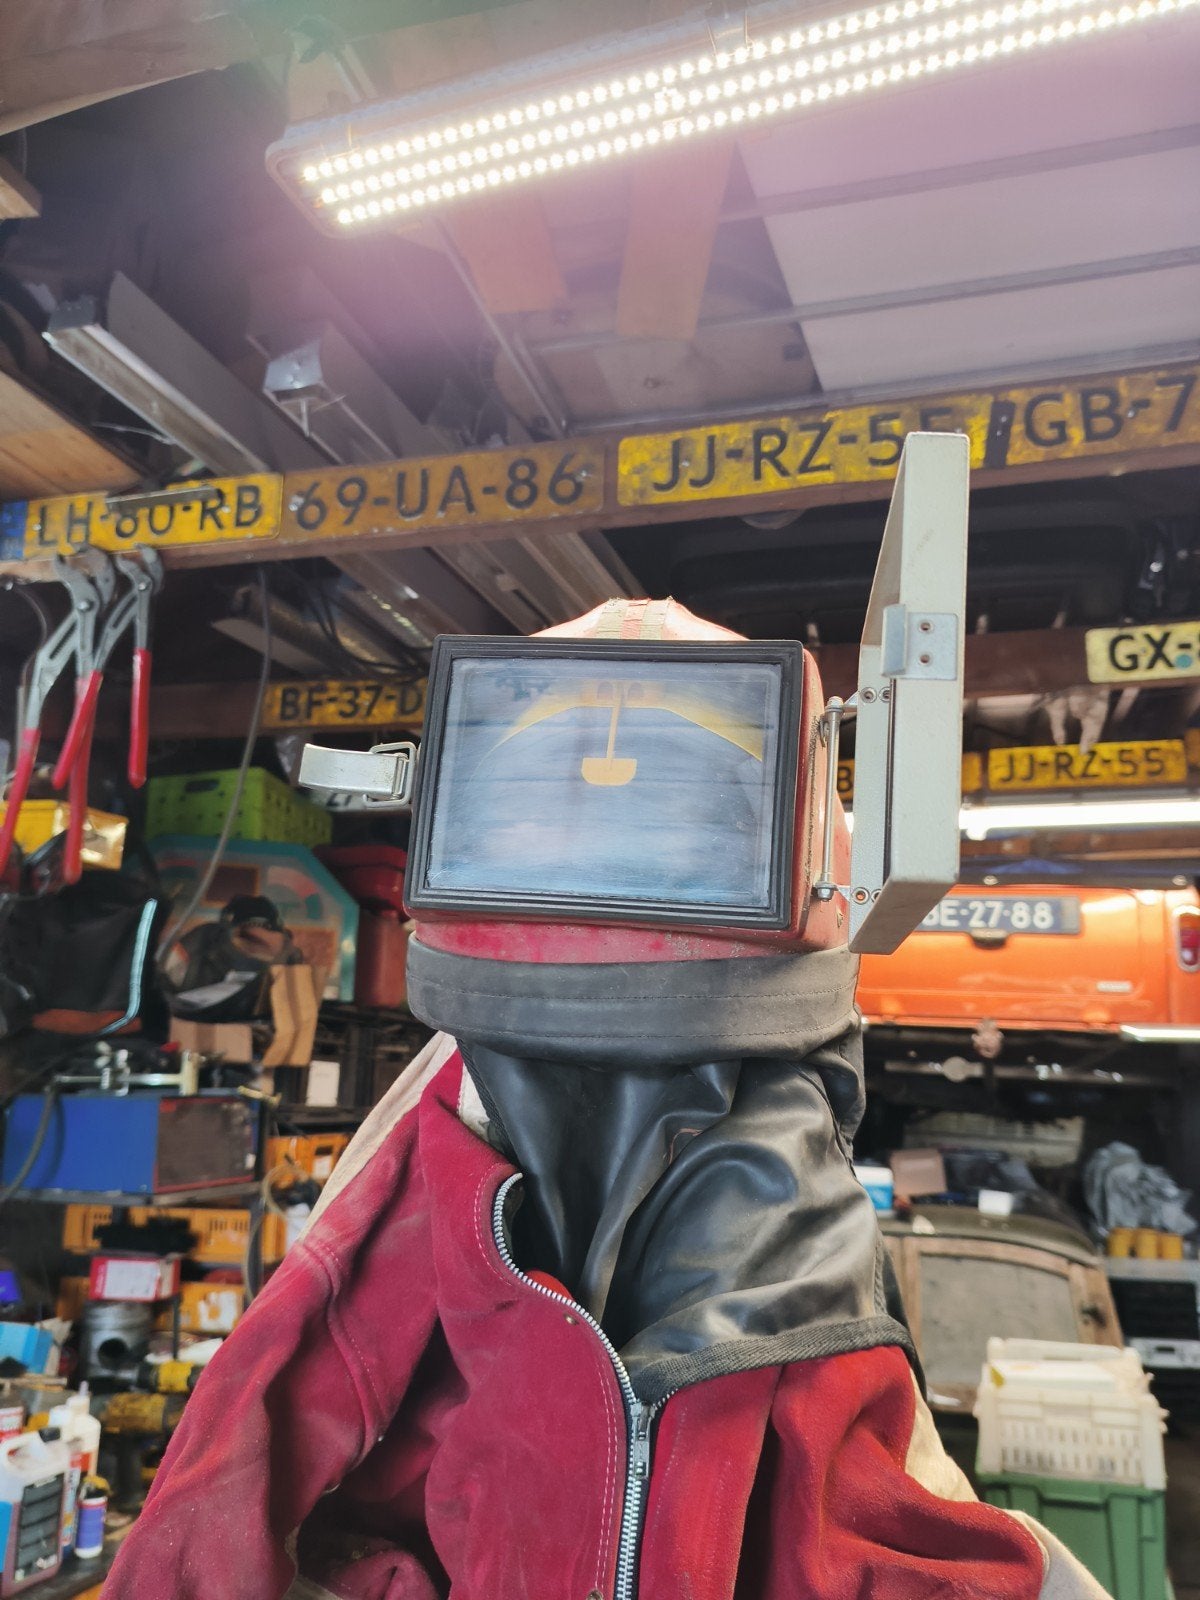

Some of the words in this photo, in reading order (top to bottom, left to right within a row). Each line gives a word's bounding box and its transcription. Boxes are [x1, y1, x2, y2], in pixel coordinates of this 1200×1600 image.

[296, 452, 594, 531] 69-UA-86
[1109, 632, 1200, 671] GX-
[1001, 747, 1165, 782] JJ-RZ-55
